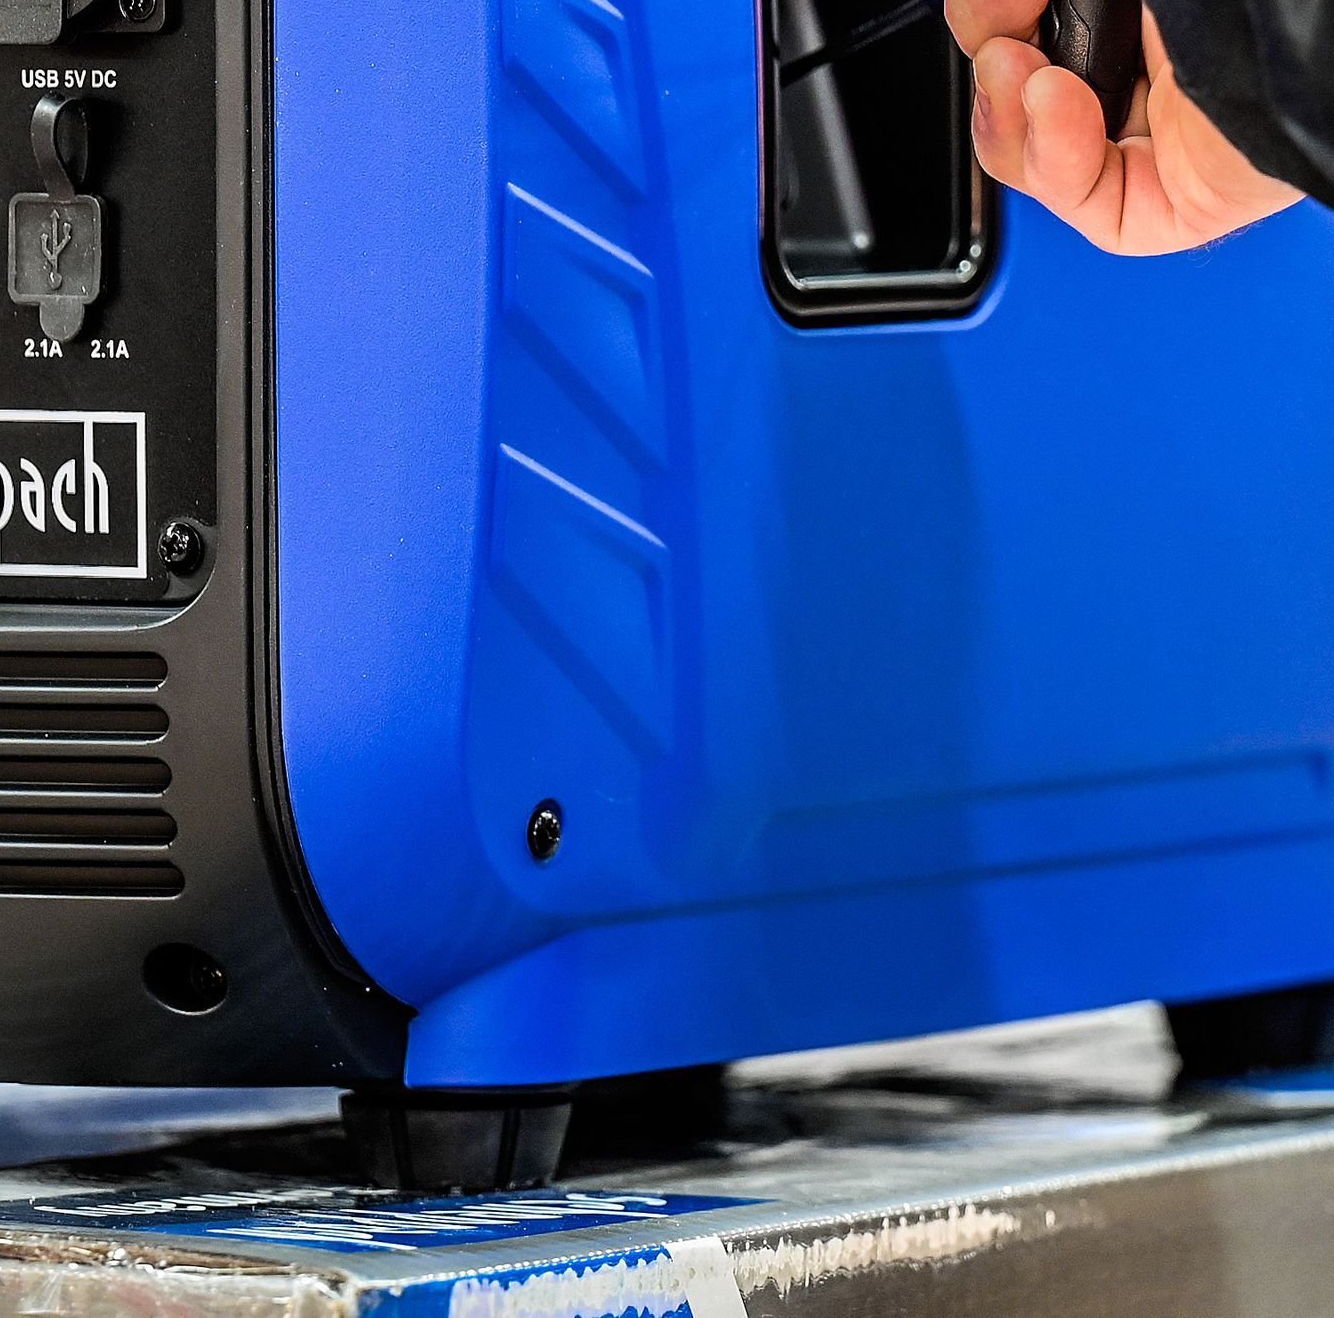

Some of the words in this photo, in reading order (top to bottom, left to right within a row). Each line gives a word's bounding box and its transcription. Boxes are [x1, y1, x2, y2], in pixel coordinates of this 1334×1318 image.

[21, 69, 60, 88] USB
[64, 69, 87, 88] 5V
[91, 69, 117, 88] DC
[24, 338, 63, 358] 2.1A
[90, 339, 130, 359] 2.1A
